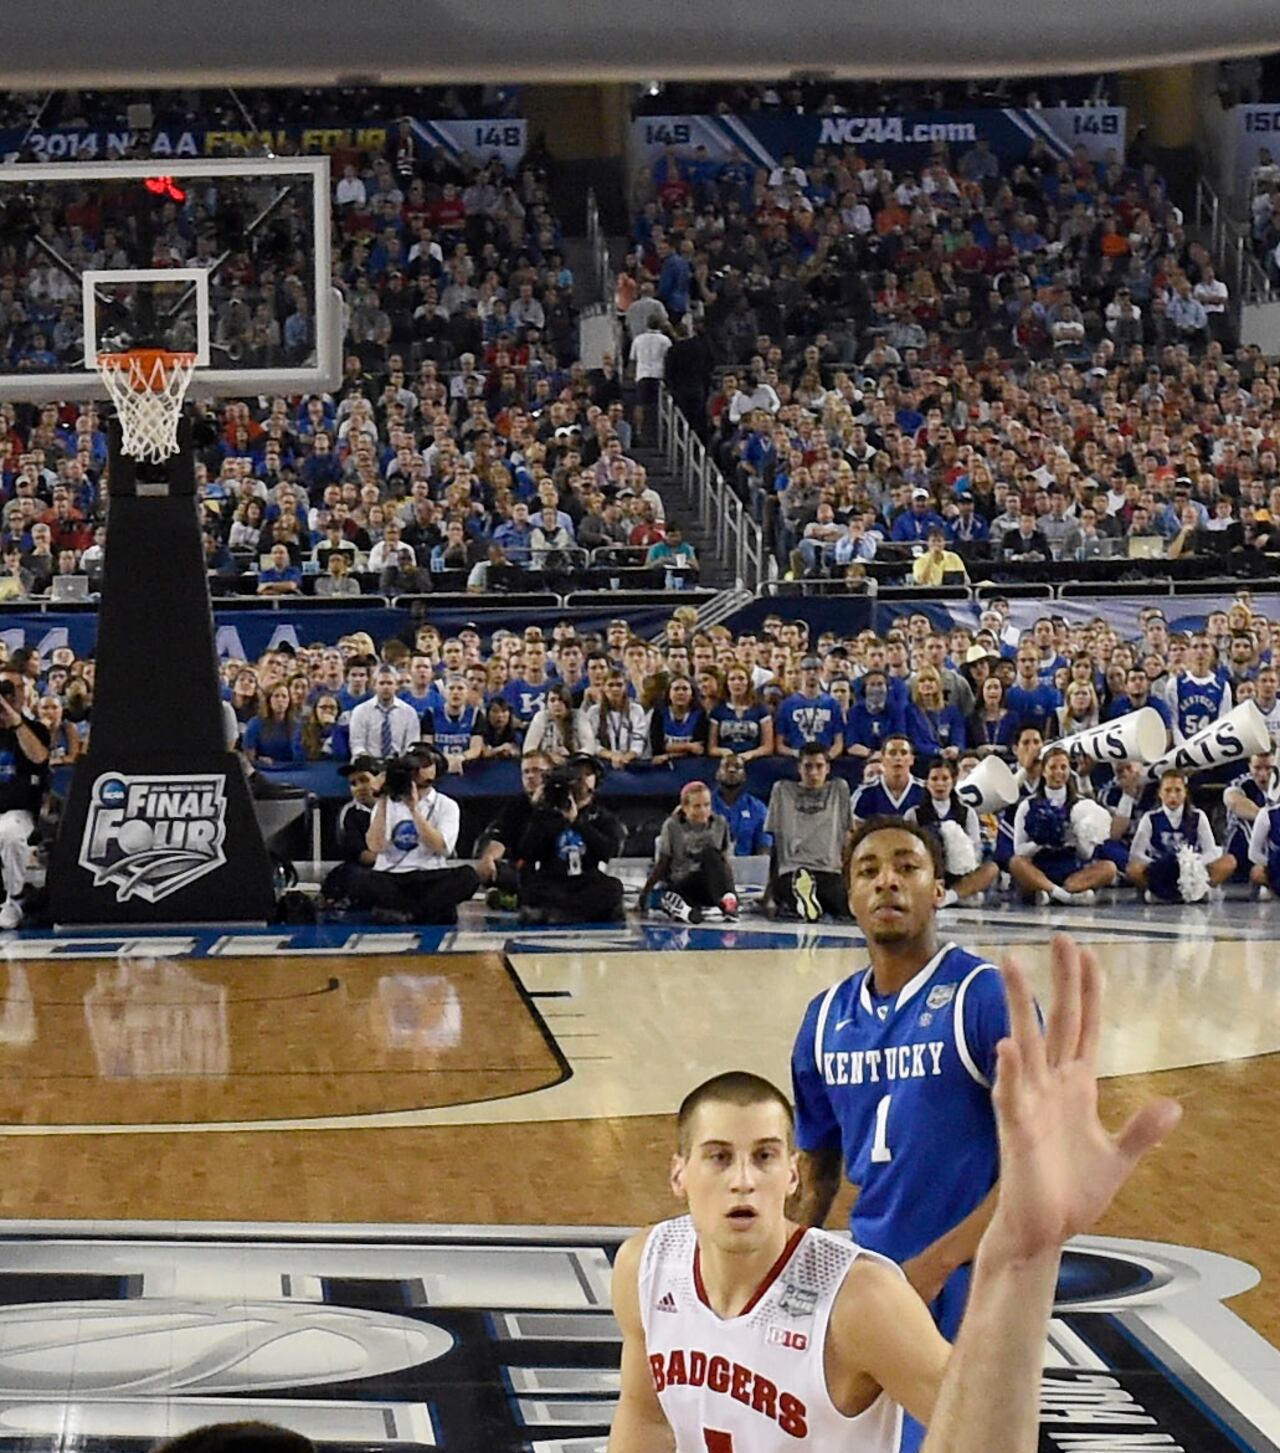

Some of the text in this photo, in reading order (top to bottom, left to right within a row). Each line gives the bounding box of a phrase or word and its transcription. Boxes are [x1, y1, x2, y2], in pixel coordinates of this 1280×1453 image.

[476, 127, 520, 146] 148
[646, 124, 690, 145] 149
[819, 117, 977, 144] NCAA.com
[1074, 114, 1118, 135] 149
[29, 132, 98, 156] 2014
[107, 131, 198, 156] NAA
[1143, 721, 1254, 780] CATS
[126, 785, 218, 818] FINAL
[90, 808, 215, 860] FOUR
[822, 1041, 945, 1086] KENTUCKY
[871, 1094, 893, 1163] 1
[649, 1349, 809, 1439] BADGERS
